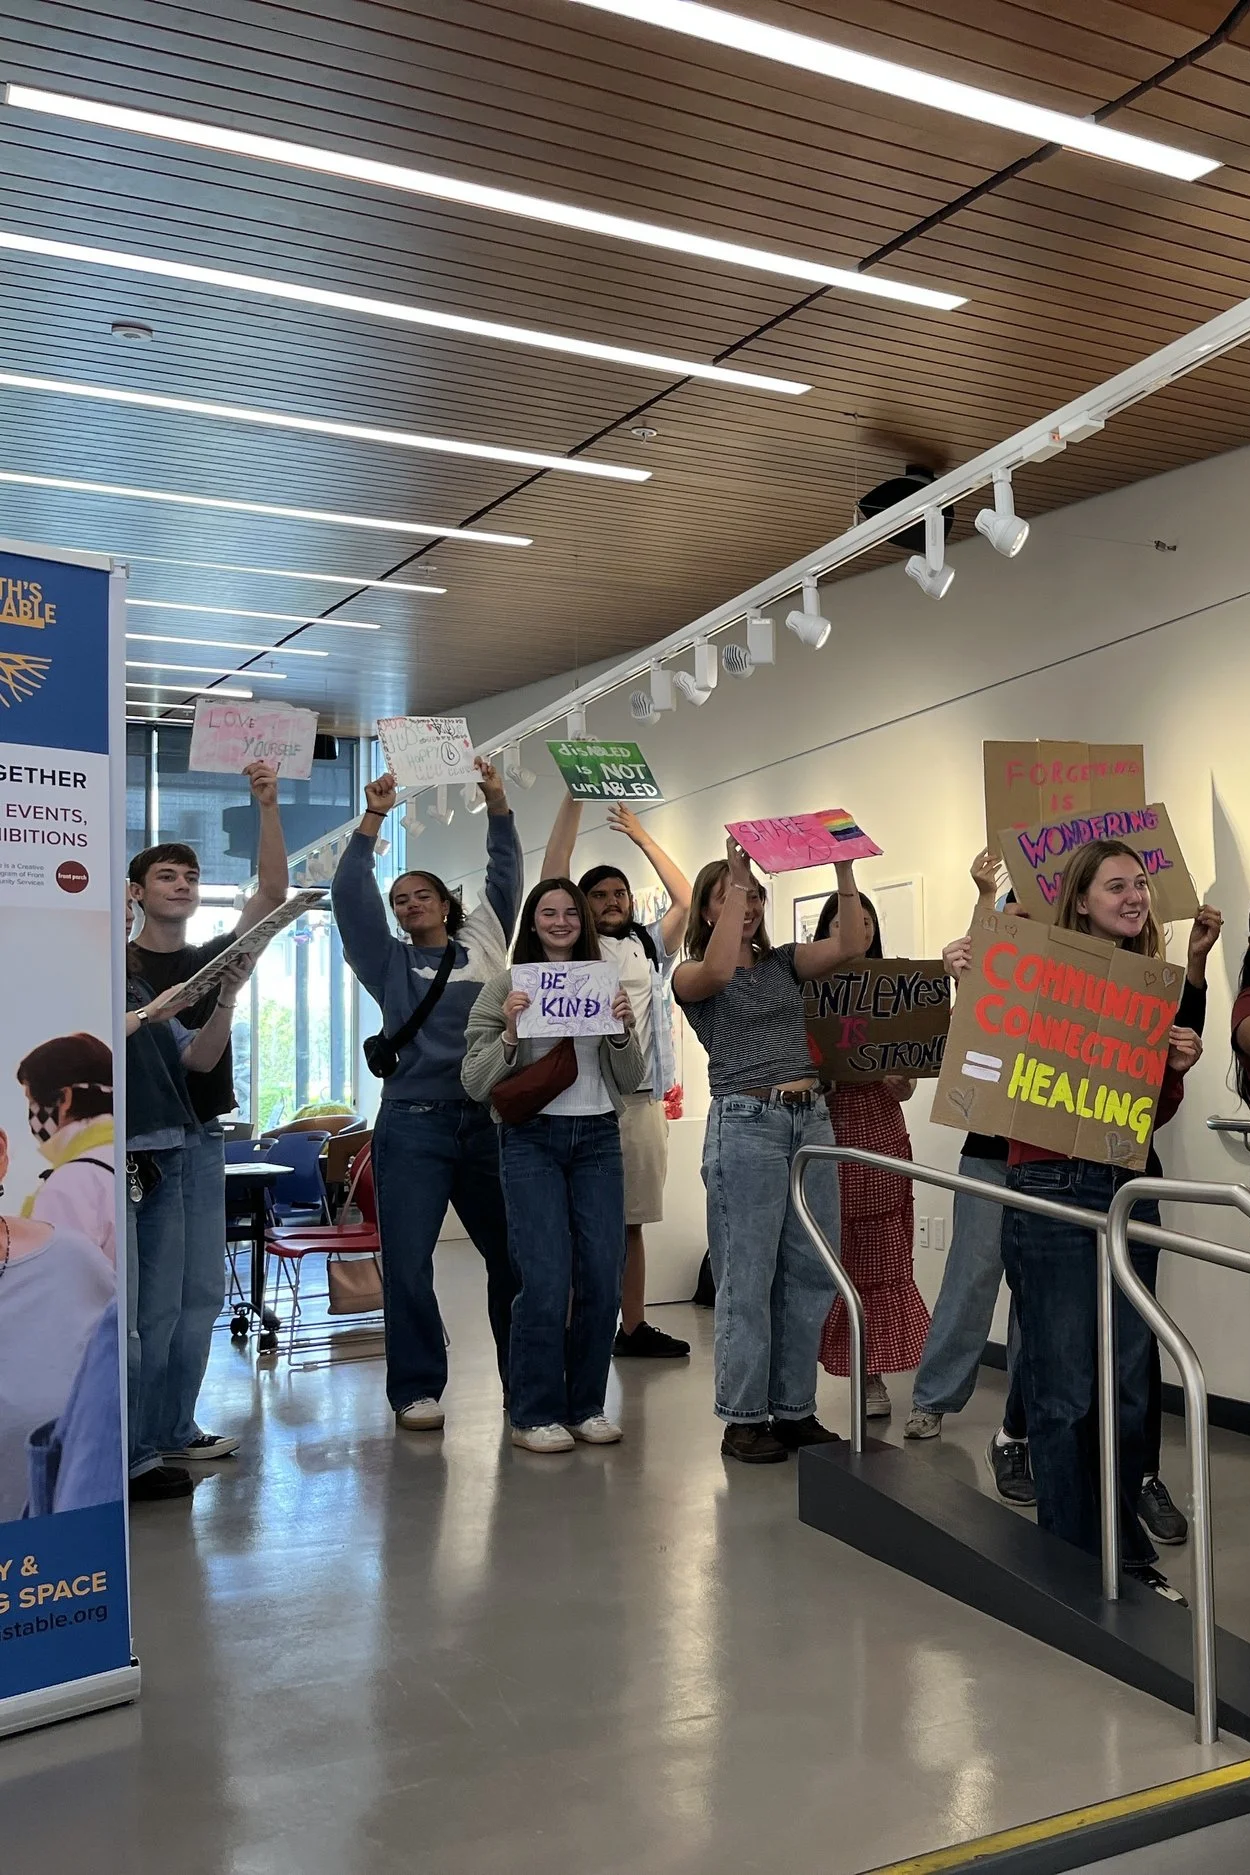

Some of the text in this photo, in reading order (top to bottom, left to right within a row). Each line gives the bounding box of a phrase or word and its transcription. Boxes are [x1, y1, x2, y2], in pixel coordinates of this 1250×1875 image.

[599, 763, 646, 780] NOT
[572, 781, 658, 797] unABLED
[6, 803, 87, 826] EVENTS,
[1049, 793, 1075, 815] IS
[0, 827, 88, 848] IBITIONS
[738, 816, 814, 843] SHARE
[1017, 807, 1159, 868] WONDERING
[541, 972, 568, 990] BE
[981, 941, 1178, 1047] COMMUNITY
[541, 996, 601, 1018] KIND
[836, 1016, 869, 1048] IS
[974, 994, 1168, 1086] CONNECTION
[1007, 1053, 1153, 1144] HEALING
[20, 1555, 39, 1577] &
[19, 1571, 107, 1609] SPACE
